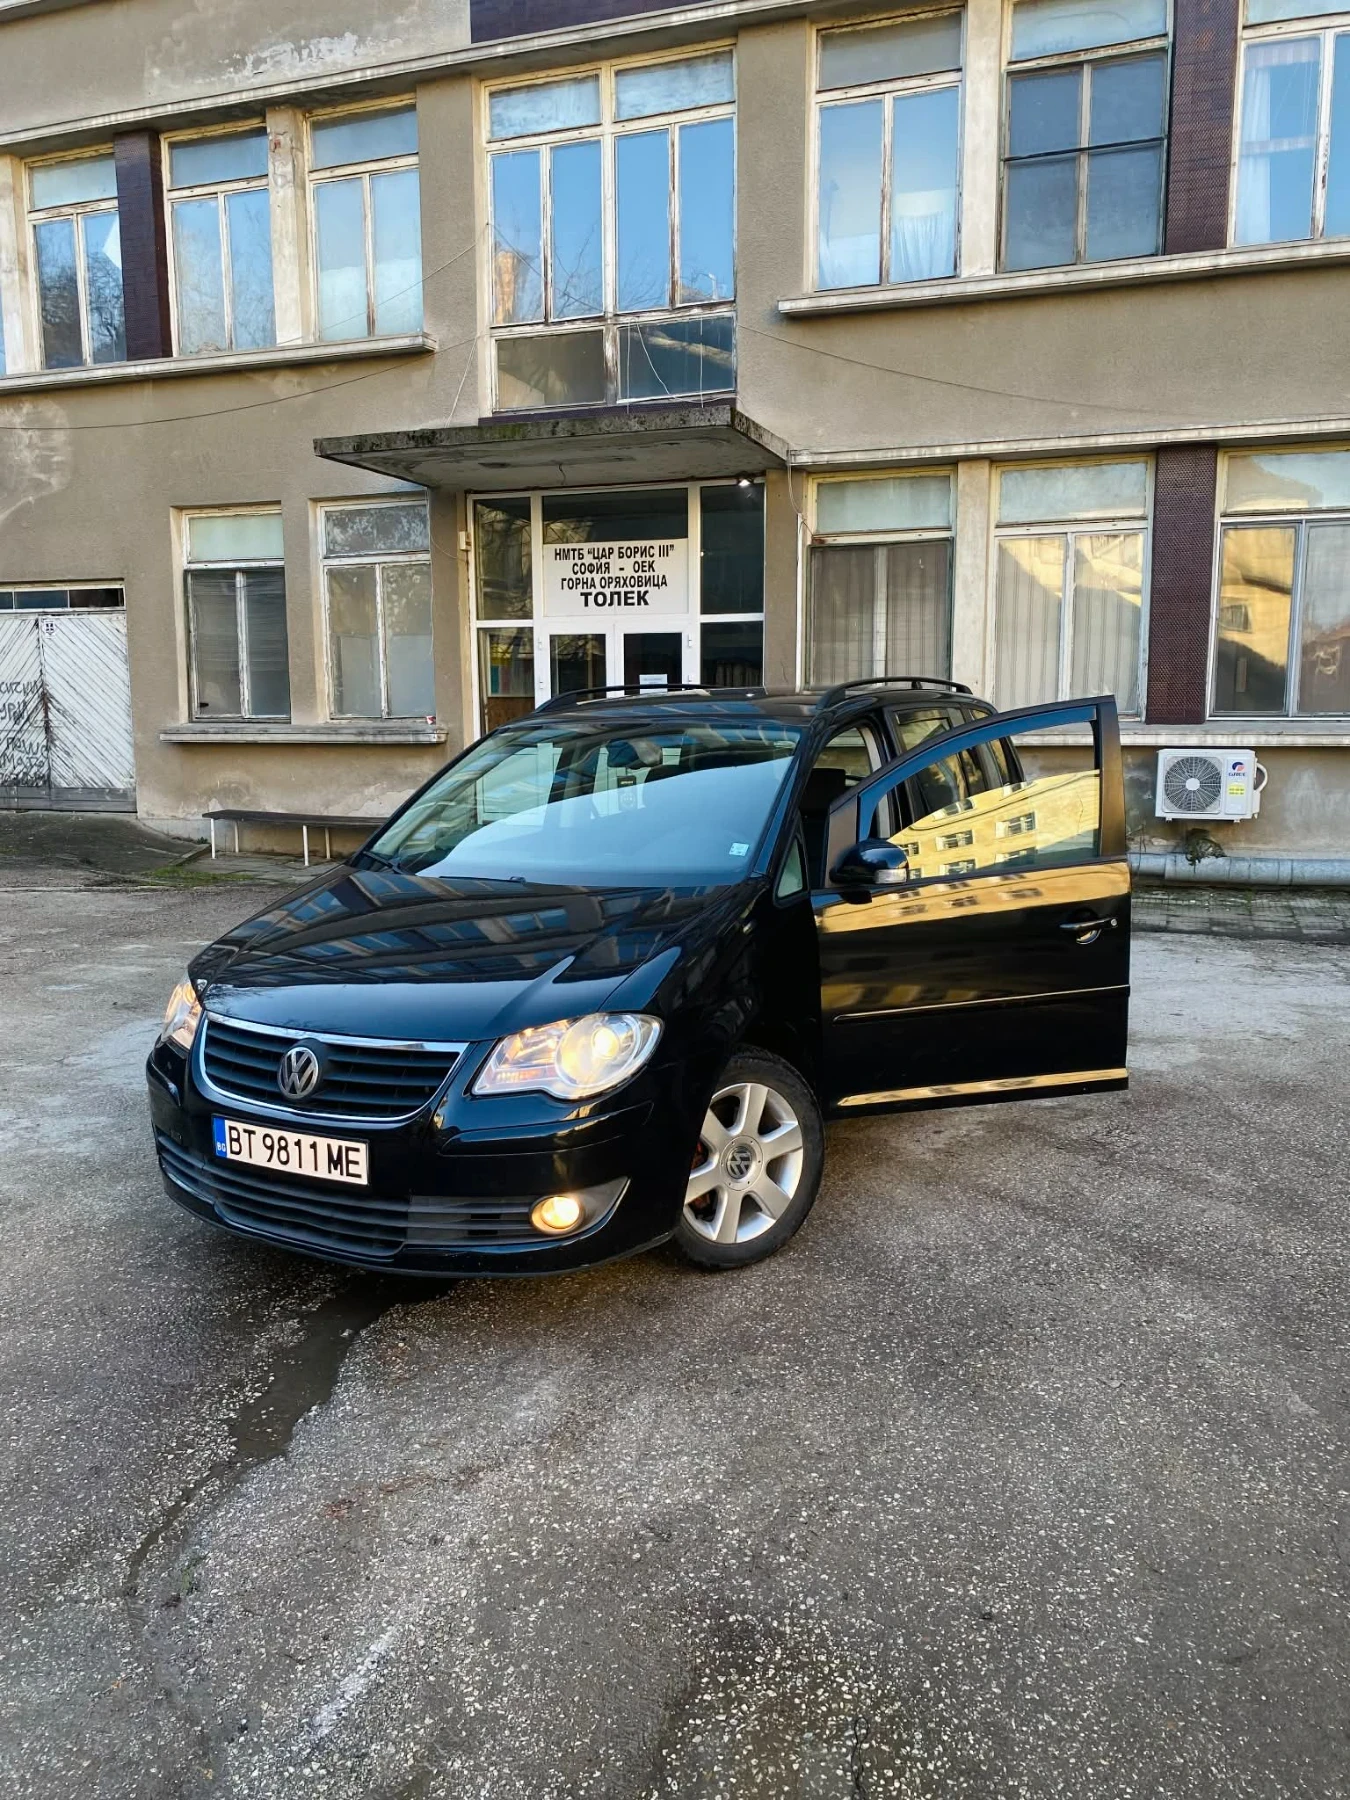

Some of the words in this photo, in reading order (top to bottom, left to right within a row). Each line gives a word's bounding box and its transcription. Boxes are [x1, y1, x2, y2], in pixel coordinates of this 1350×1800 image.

[554, 548, 584, 561] НМТБ
[617, 545, 655, 559] БОРИС
[572, 562, 610, 575] СОФИЯ
[633, 560, 655, 573] ОЕК
[561, 577, 596, 590] ГОРНА
[600, 574, 668, 590] ОРЯХОВИЦА
[580, 590, 649, 607] ТОЛЕК
[228, 1125, 256, 1159] BT
[262, 1133, 318, 1172] 9811
[327, 1143, 362, 1179] ME
